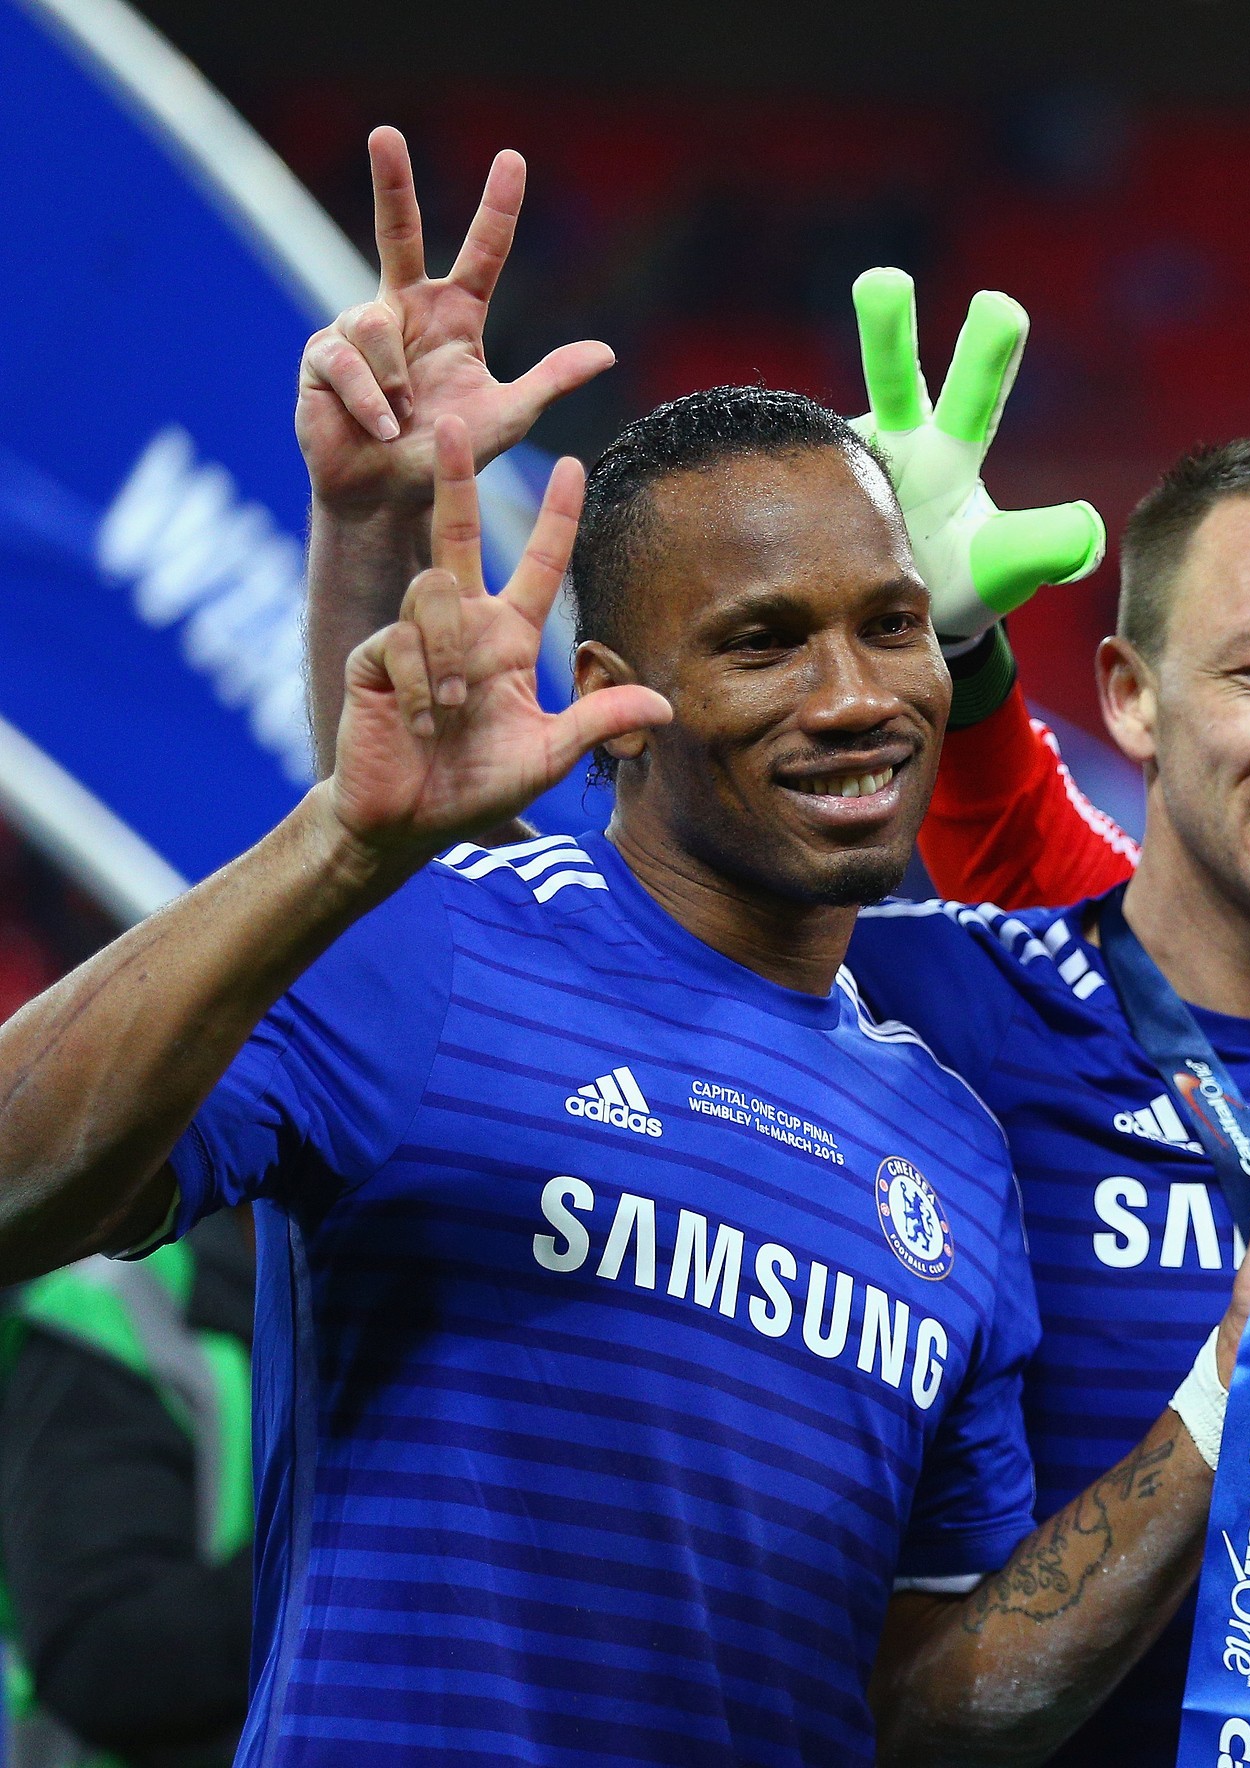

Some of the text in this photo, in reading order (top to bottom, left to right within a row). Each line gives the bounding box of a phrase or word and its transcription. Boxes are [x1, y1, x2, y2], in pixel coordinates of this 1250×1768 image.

[565, 1094, 663, 1138] adidas
[688, 1097, 845, 1166] WEMBLEY 1st MARCH 2015
[691, 1080, 839, 1149] CAPITAL ONE CUP FINAL
[887, 1160, 935, 1206] CHELSEA
[890, 1233, 927, 1273] FOOTBALL
[1093, 1176, 1247, 1270] SA
[533, 1176, 948, 1410] SAMSUNG
